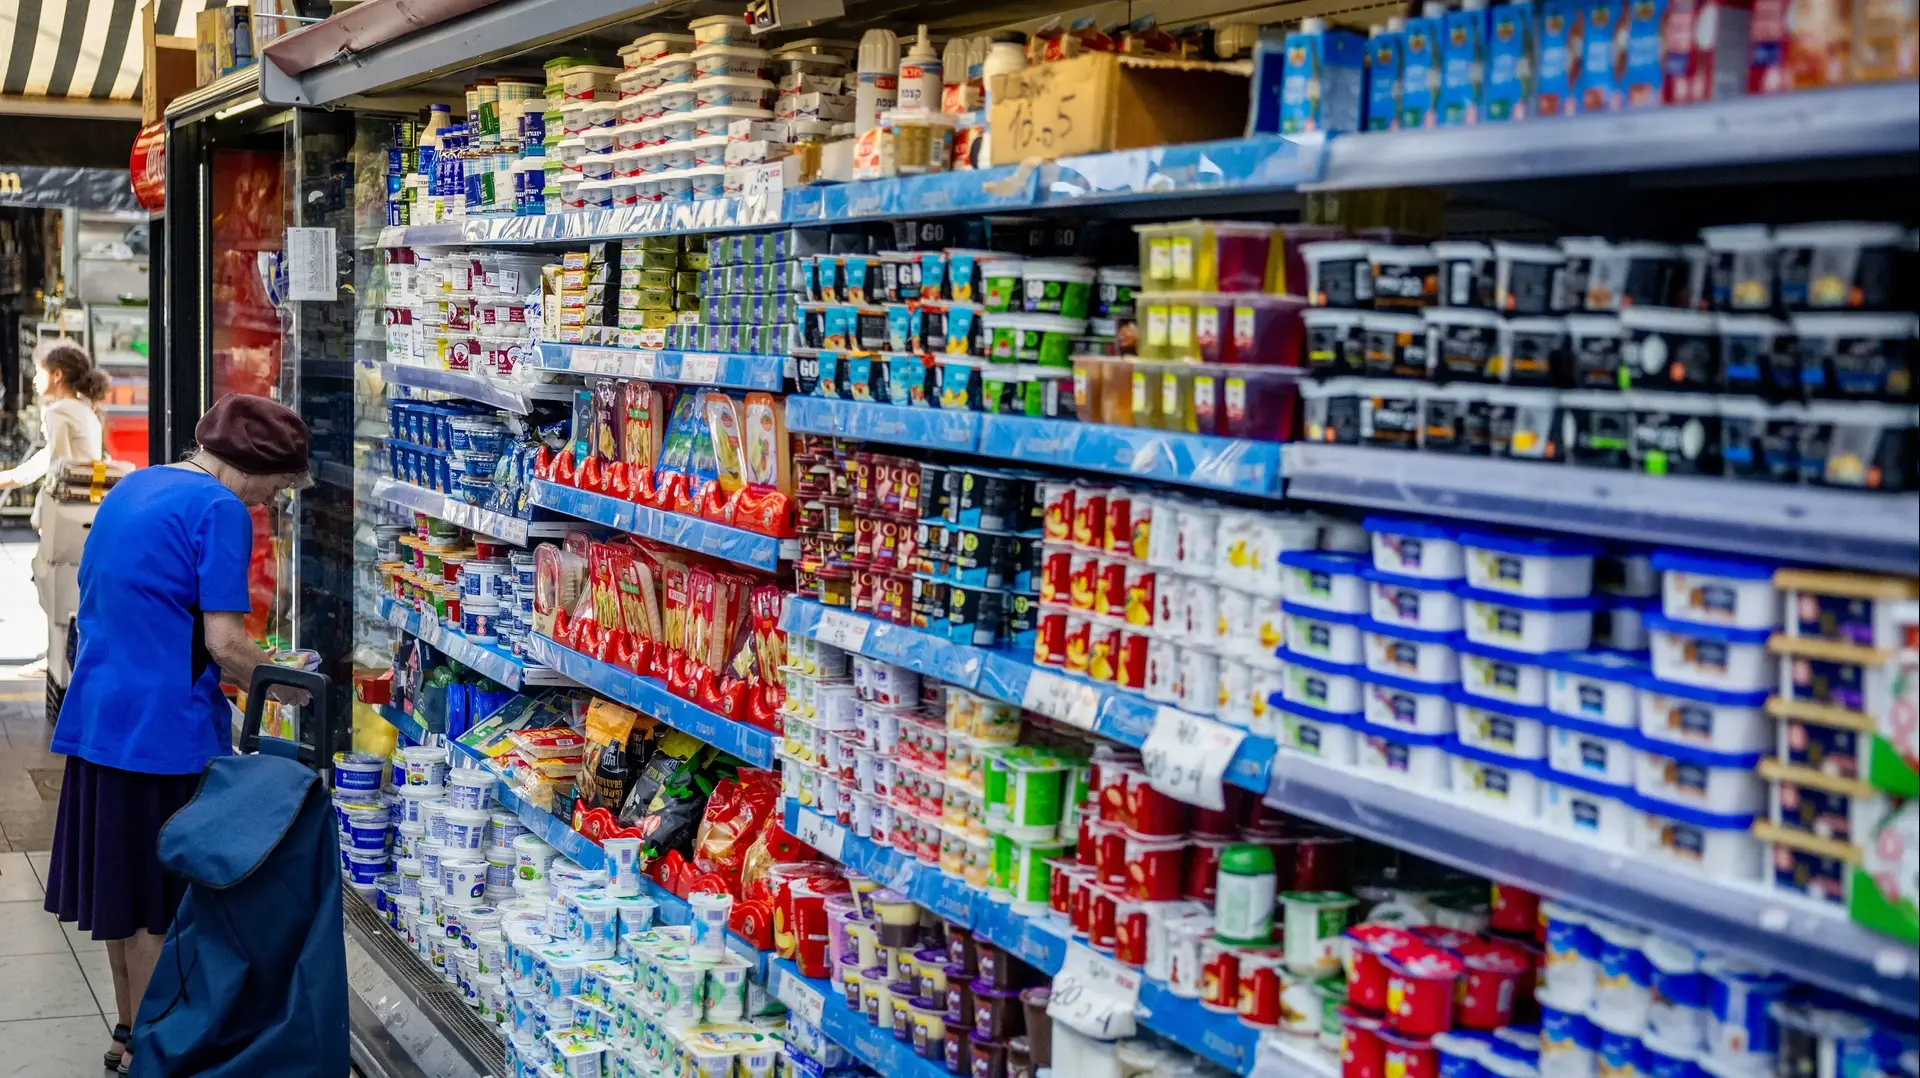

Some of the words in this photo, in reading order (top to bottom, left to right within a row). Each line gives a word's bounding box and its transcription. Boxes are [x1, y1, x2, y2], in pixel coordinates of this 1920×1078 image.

[921, 223, 944, 242] GO
[898, 263, 922, 285] GO
[799, 358, 820, 378] GO
[1052, 976, 1083, 1006] 20
